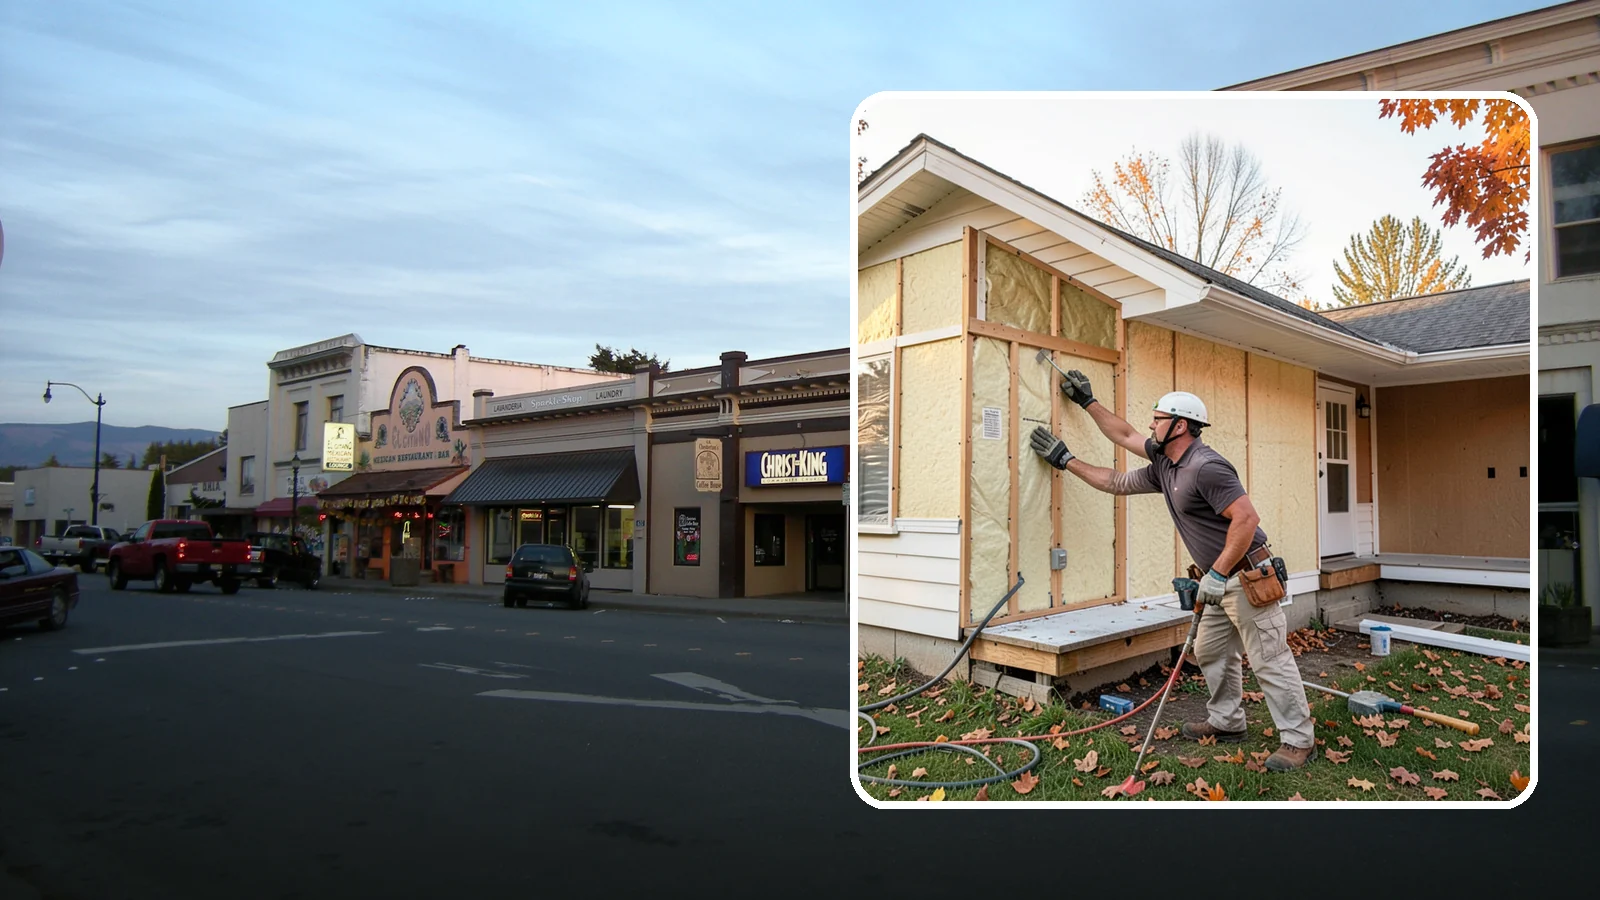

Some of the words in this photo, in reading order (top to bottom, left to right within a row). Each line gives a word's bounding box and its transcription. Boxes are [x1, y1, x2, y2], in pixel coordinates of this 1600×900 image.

[595, 389, 623, 400] LAUNDRY
[494, 402, 522, 412] LAVANDERIA
[531, 396, 561, 408] Sparkle
[562, 394, 582, 404] Shop
[398, 452, 434, 462] RESTAURANT
[438, 450, 450, 459] BAR
[761, 452, 797, 478] CHRIST
[799, 450, 827, 476] KING
